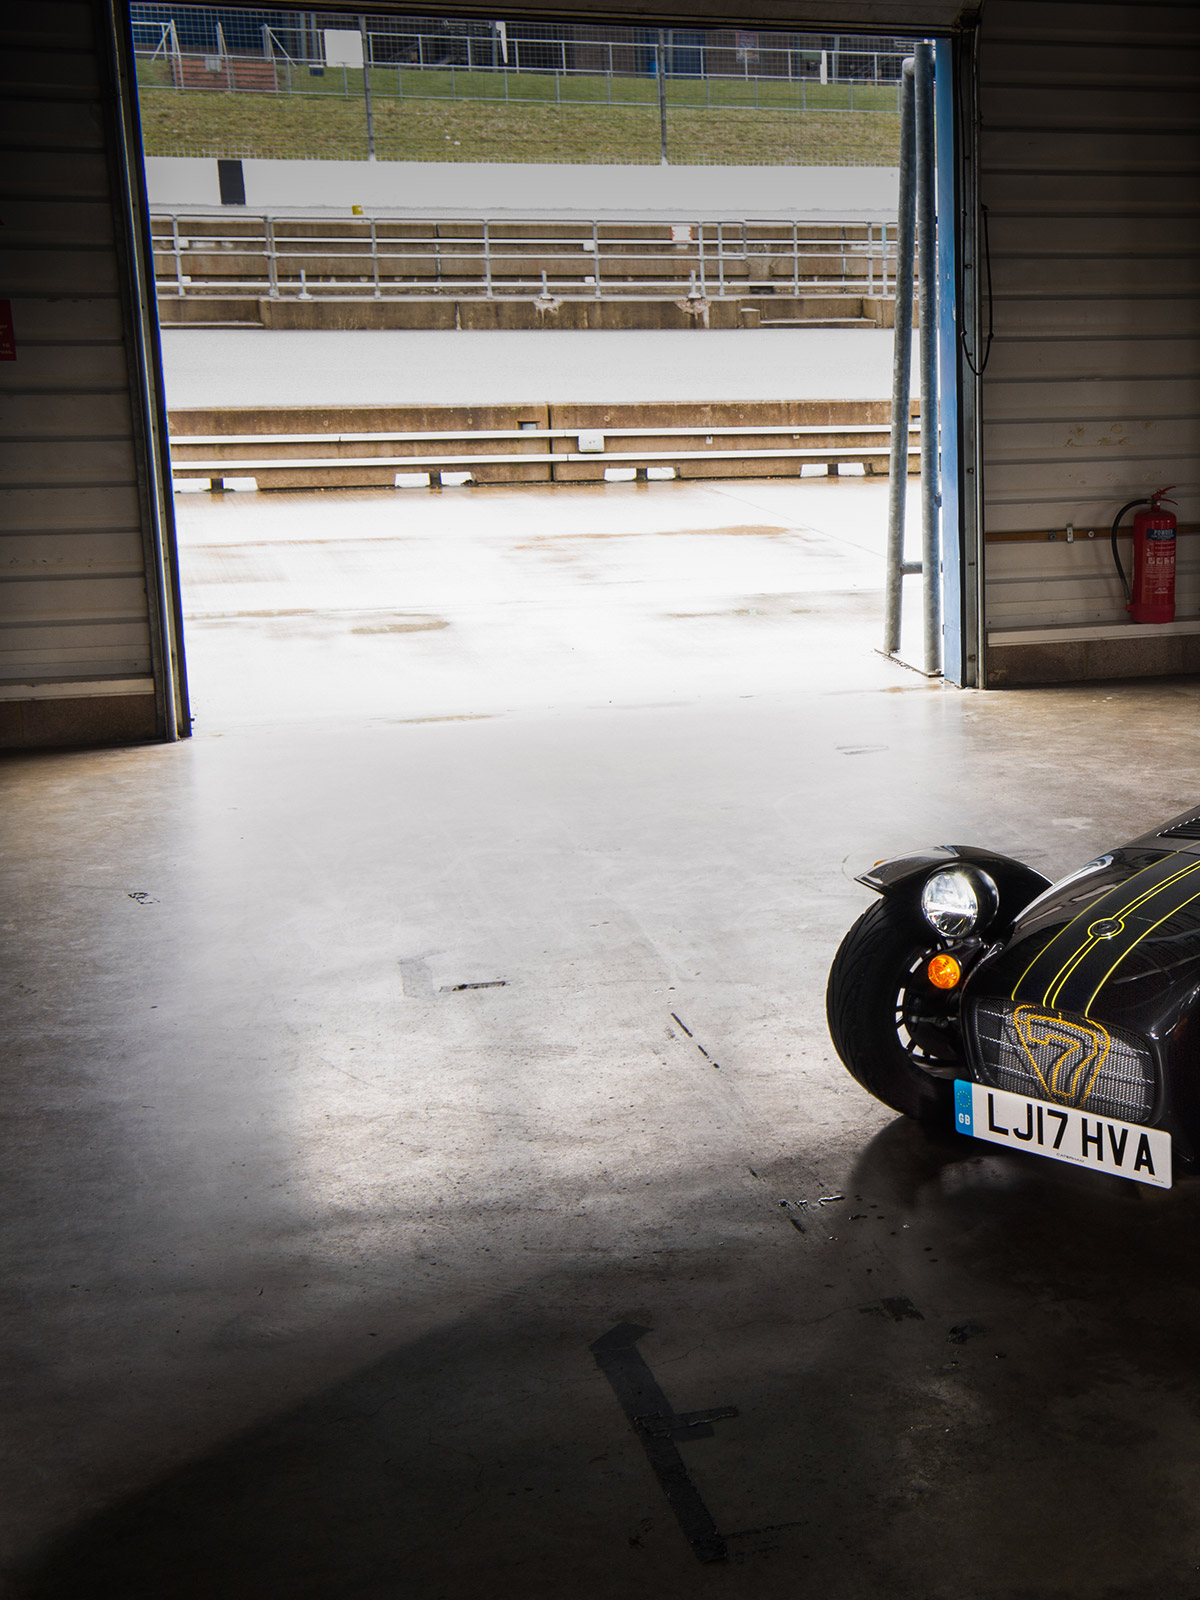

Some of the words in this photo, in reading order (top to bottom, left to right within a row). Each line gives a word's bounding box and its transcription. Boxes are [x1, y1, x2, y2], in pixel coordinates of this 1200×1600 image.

[958, 1112, 971, 1126] GB
[987, 1092, 1069, 1150] LJ17
[1080, 1117, 1156, 1176] HVA
